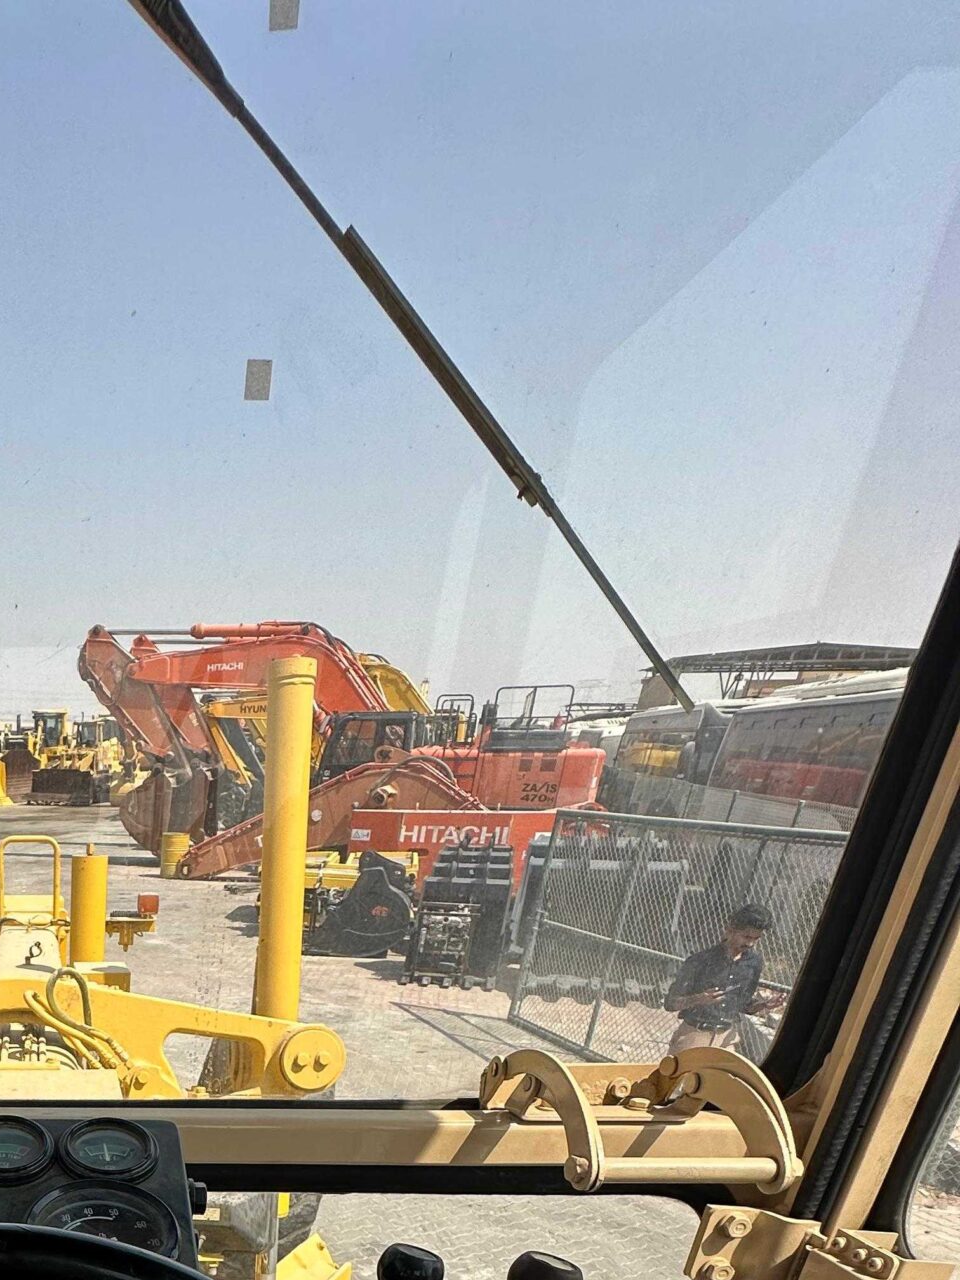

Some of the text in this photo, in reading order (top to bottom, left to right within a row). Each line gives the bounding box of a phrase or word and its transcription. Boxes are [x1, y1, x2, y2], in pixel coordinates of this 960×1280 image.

[206, 662, 244, 672] HITACHI
[240, 704, 267, 714] HYUN
[399, 824, 510, 845] HITACHI
[83, 1207, 94, 1215] 40
[108, 1208, 119, 1216] 50
